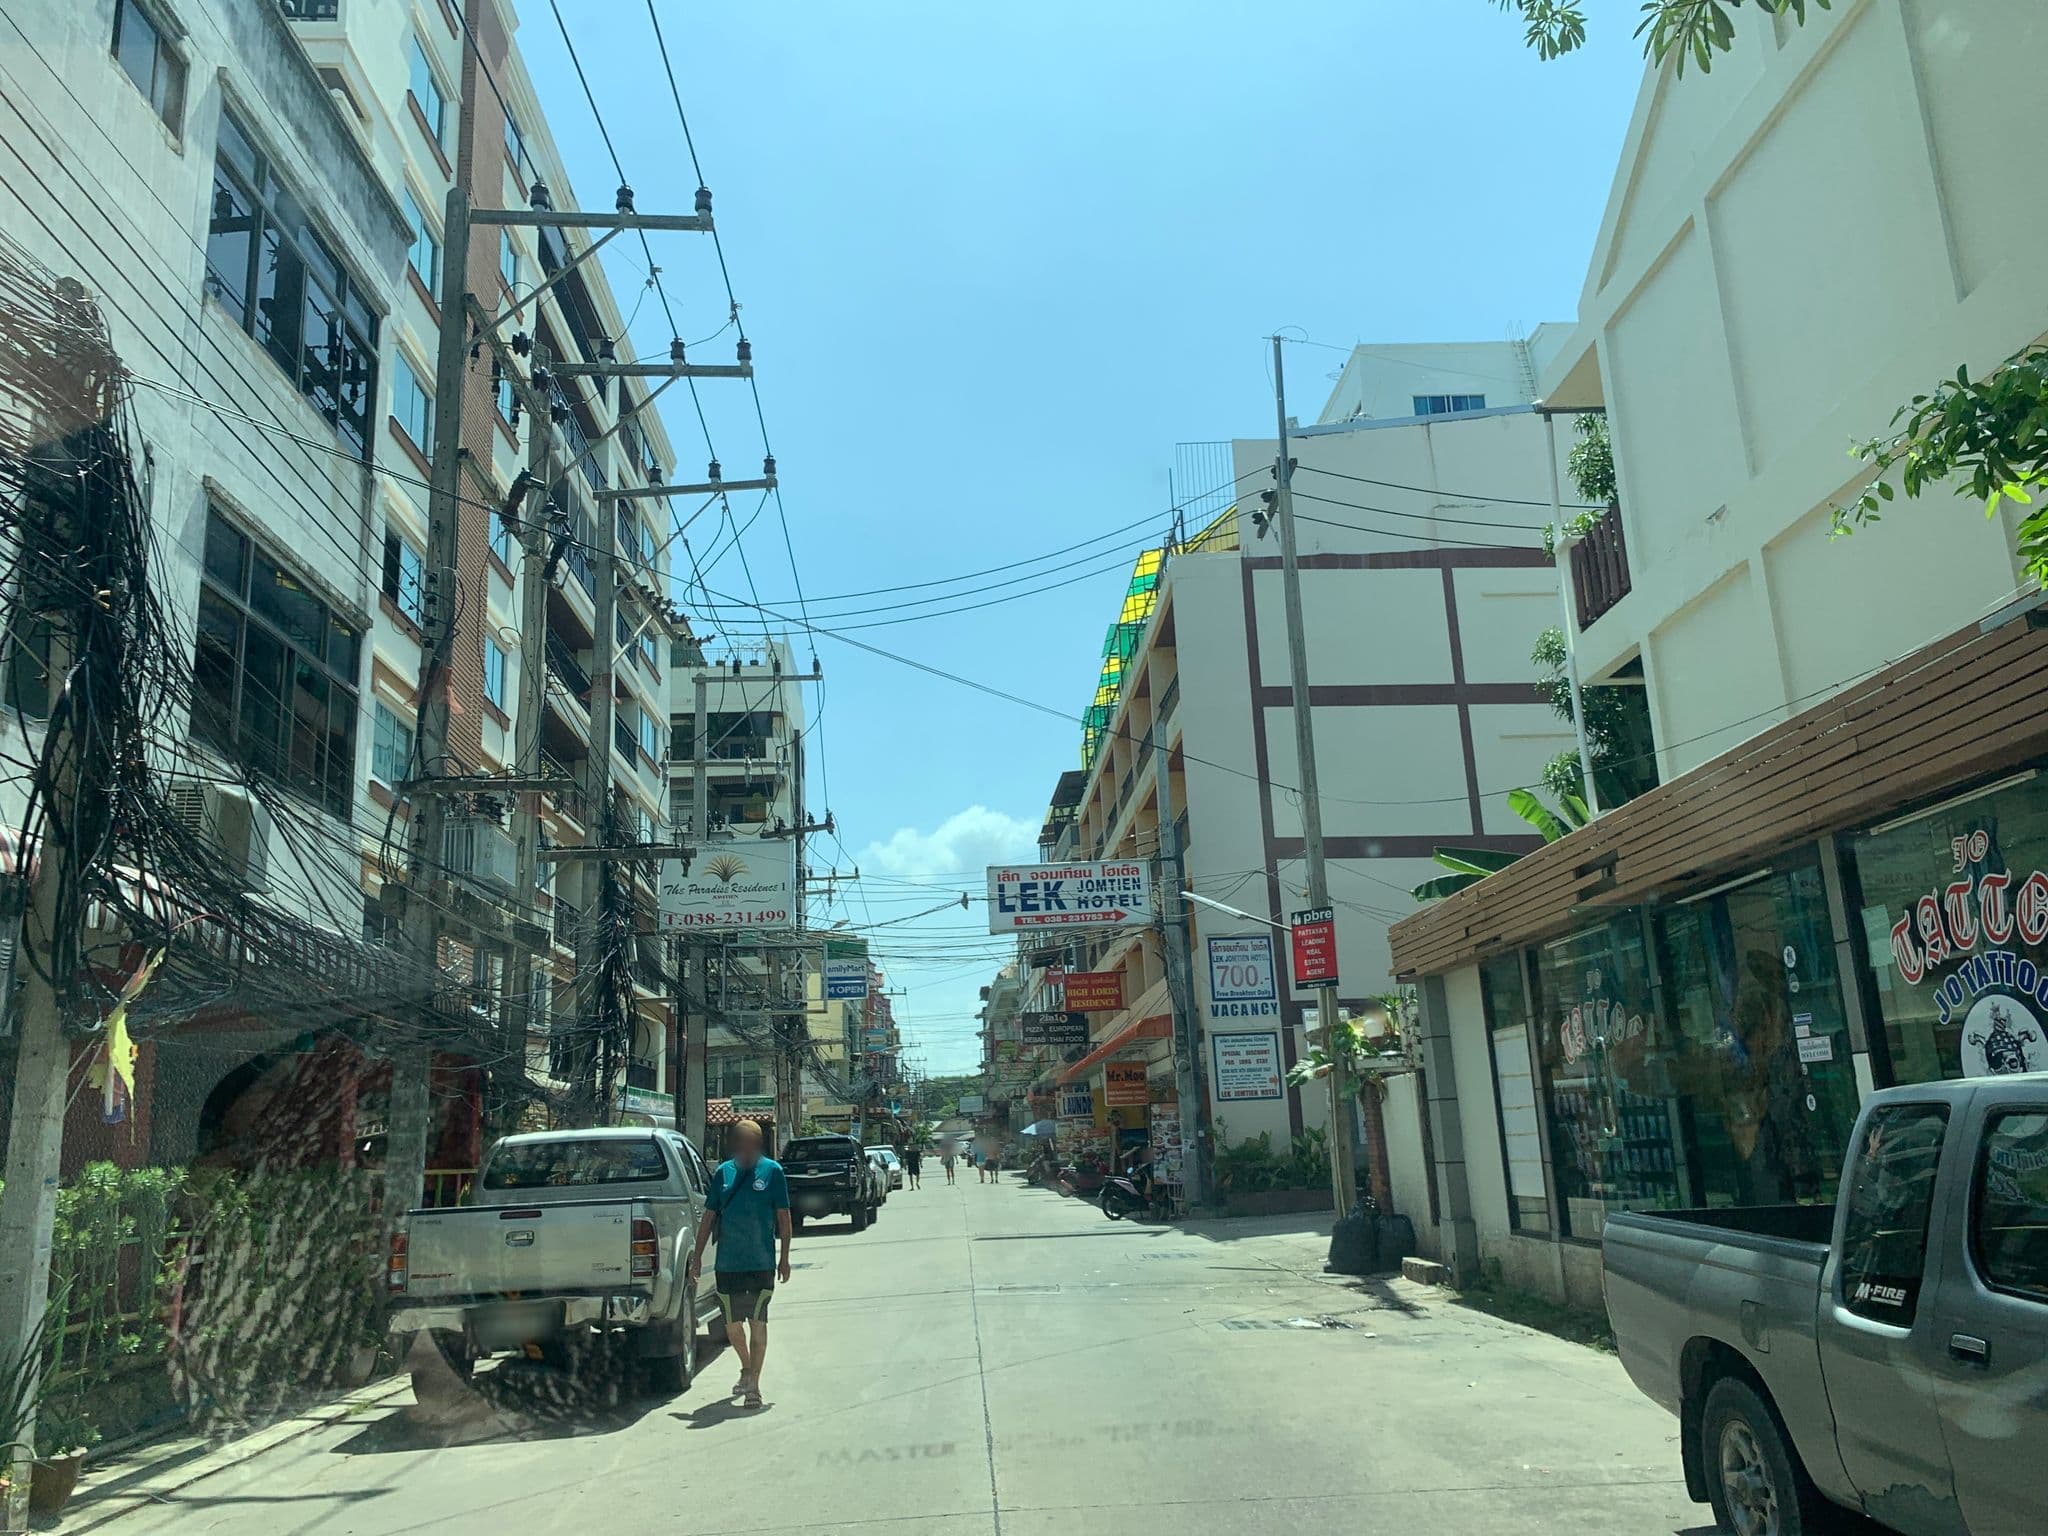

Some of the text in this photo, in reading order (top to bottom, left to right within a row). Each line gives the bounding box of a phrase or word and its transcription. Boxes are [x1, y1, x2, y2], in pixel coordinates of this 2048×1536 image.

[1951, 830, 1988, 873] JO
[664, 883, 686, 895] The
[688, 881, 729, 895] Paradise
[730, 882, 779, 893] Residence
[997, 877, 1141, 913] LEK JOMTIEN
[1077, 893, 1142, 909] HOTEL
[1020, 916, 1041, 924] TEL.
[1303, 910, 1332, 925] pbre
[827, 964, 865, 973] amilyMart
[1306, 968, 1325, 976] AGENT
[836, 985, 864, 994] OPEN
[1211, 1002, 1278, 1017] VACANCY
[1048, 1025, 1084, 1033] EUROPEAN
